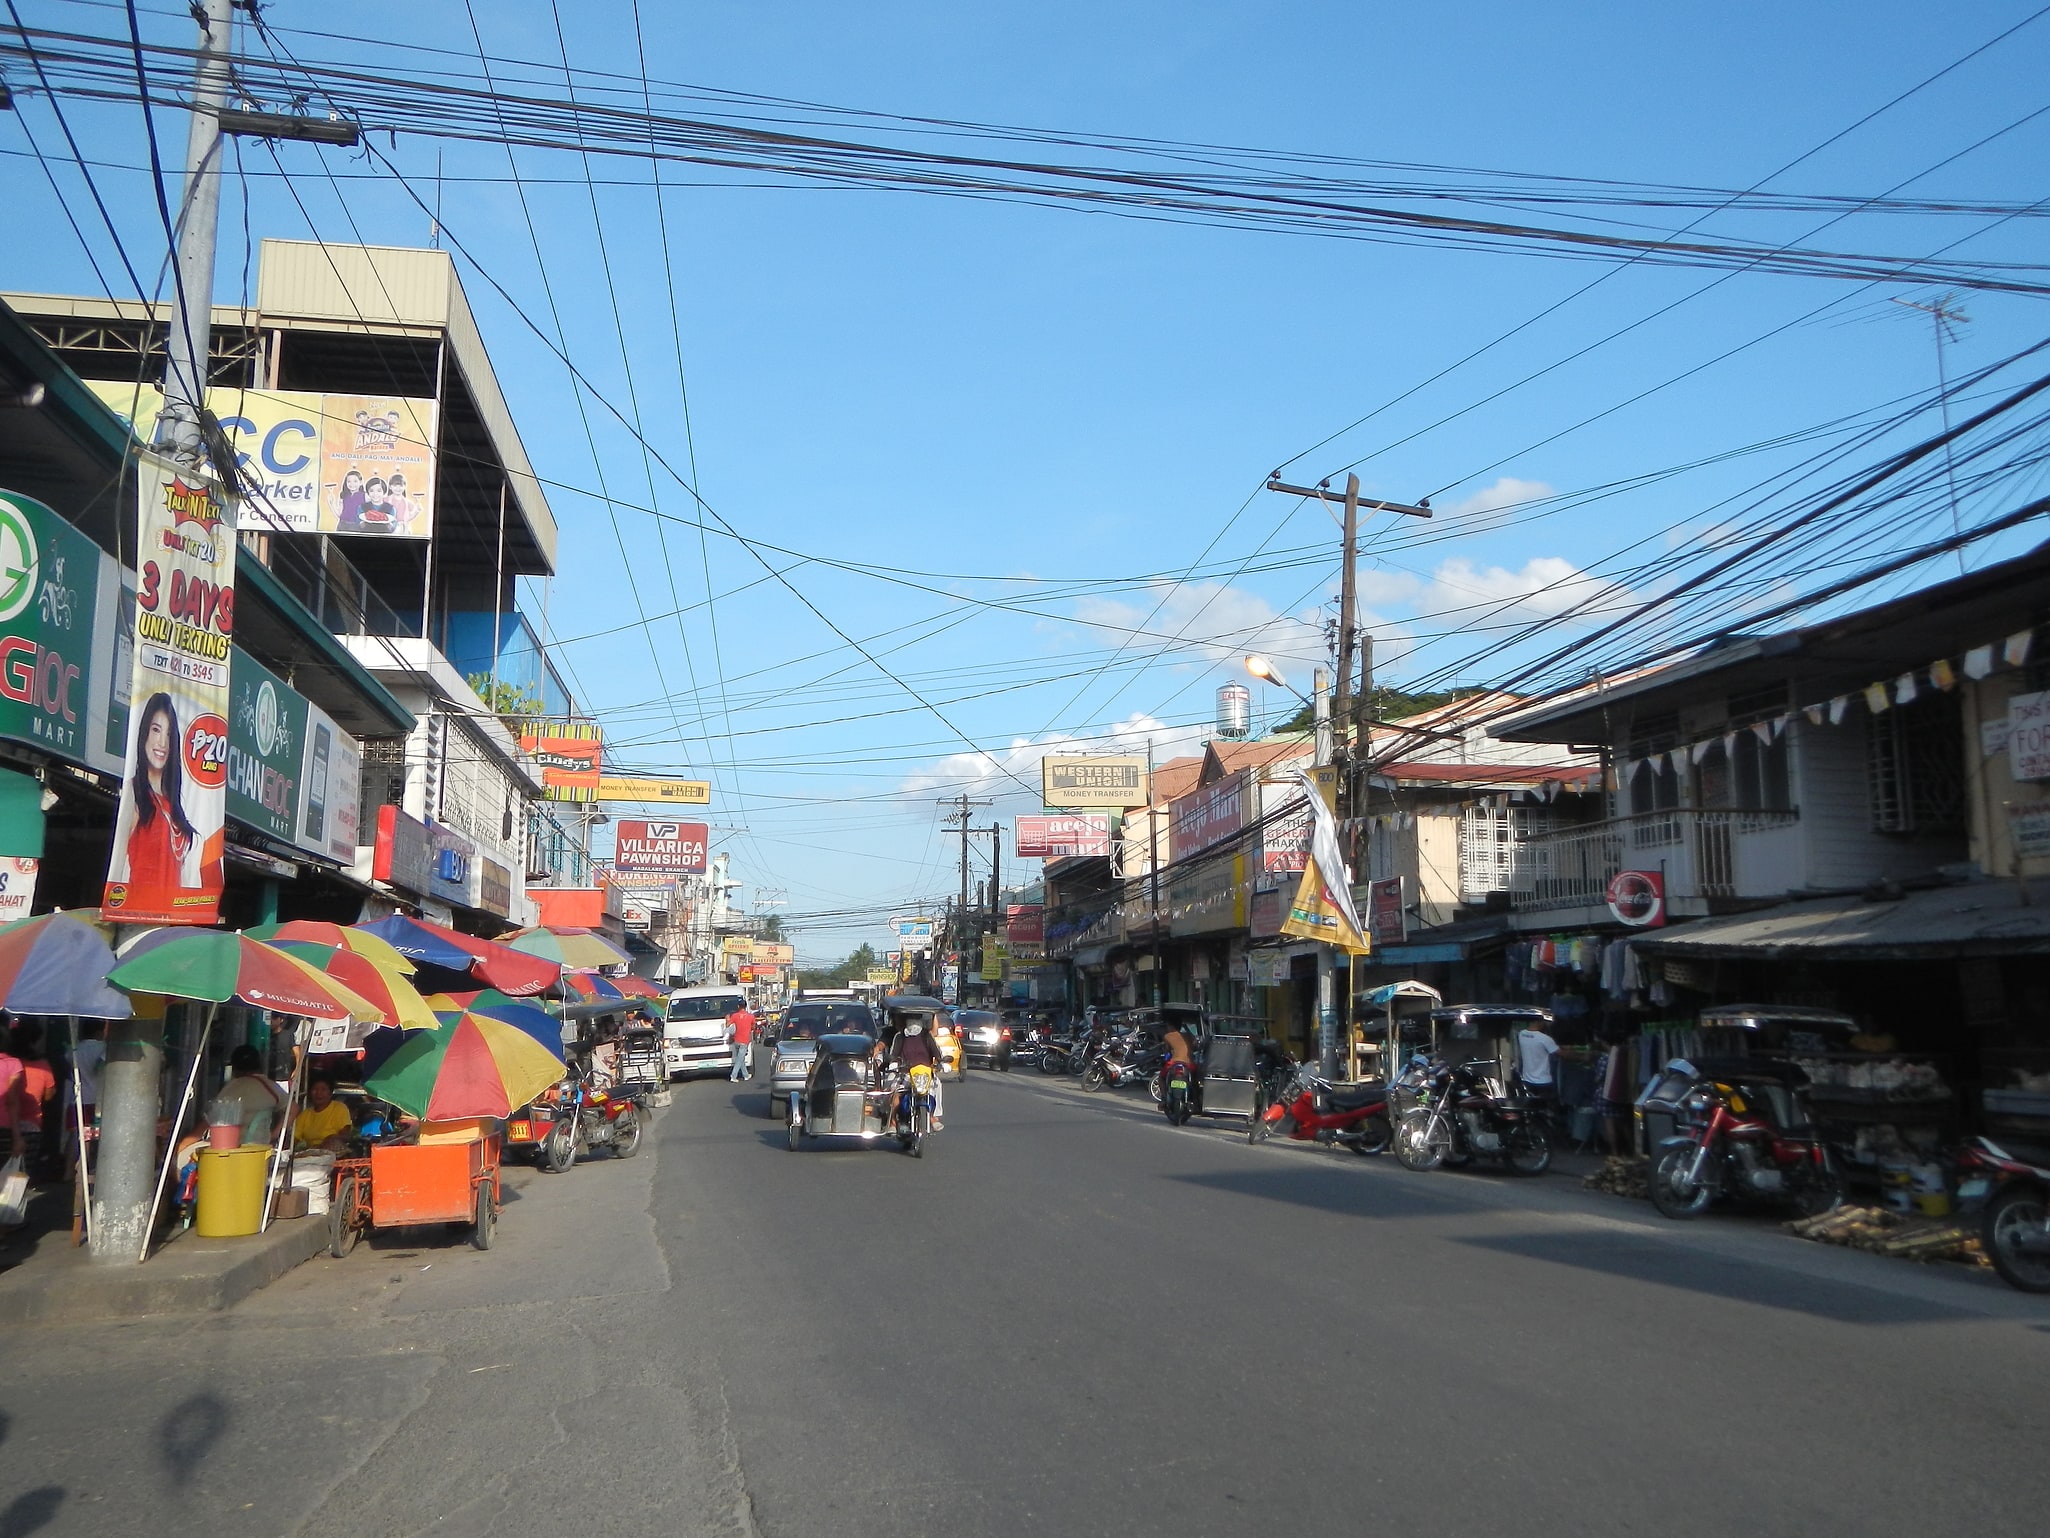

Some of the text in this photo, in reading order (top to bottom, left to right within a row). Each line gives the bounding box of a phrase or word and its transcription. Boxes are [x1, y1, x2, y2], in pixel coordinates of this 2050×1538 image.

[137, 560, 234, 635] 3 DAYS
[139, 612, 173, 645] UNLI
[154, 654, 168, 668] TEXT
[192, 663, 213, 680] 3545
[33, 717, 74, 747] MART
[202, 760, 218, 772] LANG
[1054, 767, 1123, 777] WESTERN
[1076, 776, 1123, 786] UNION
[270, 815, 289, 836] MART
[650, 824, 677, 837] VP
[1050, 816, 1106, 836] acejo
[620, 838, 704, 854] VILLARICA
[620, 852, 701, 865] PAWNSHOP
[613, 879, 667, 887] AWNSHOP
[266, 992, 334, 1012] MICROMATIC
